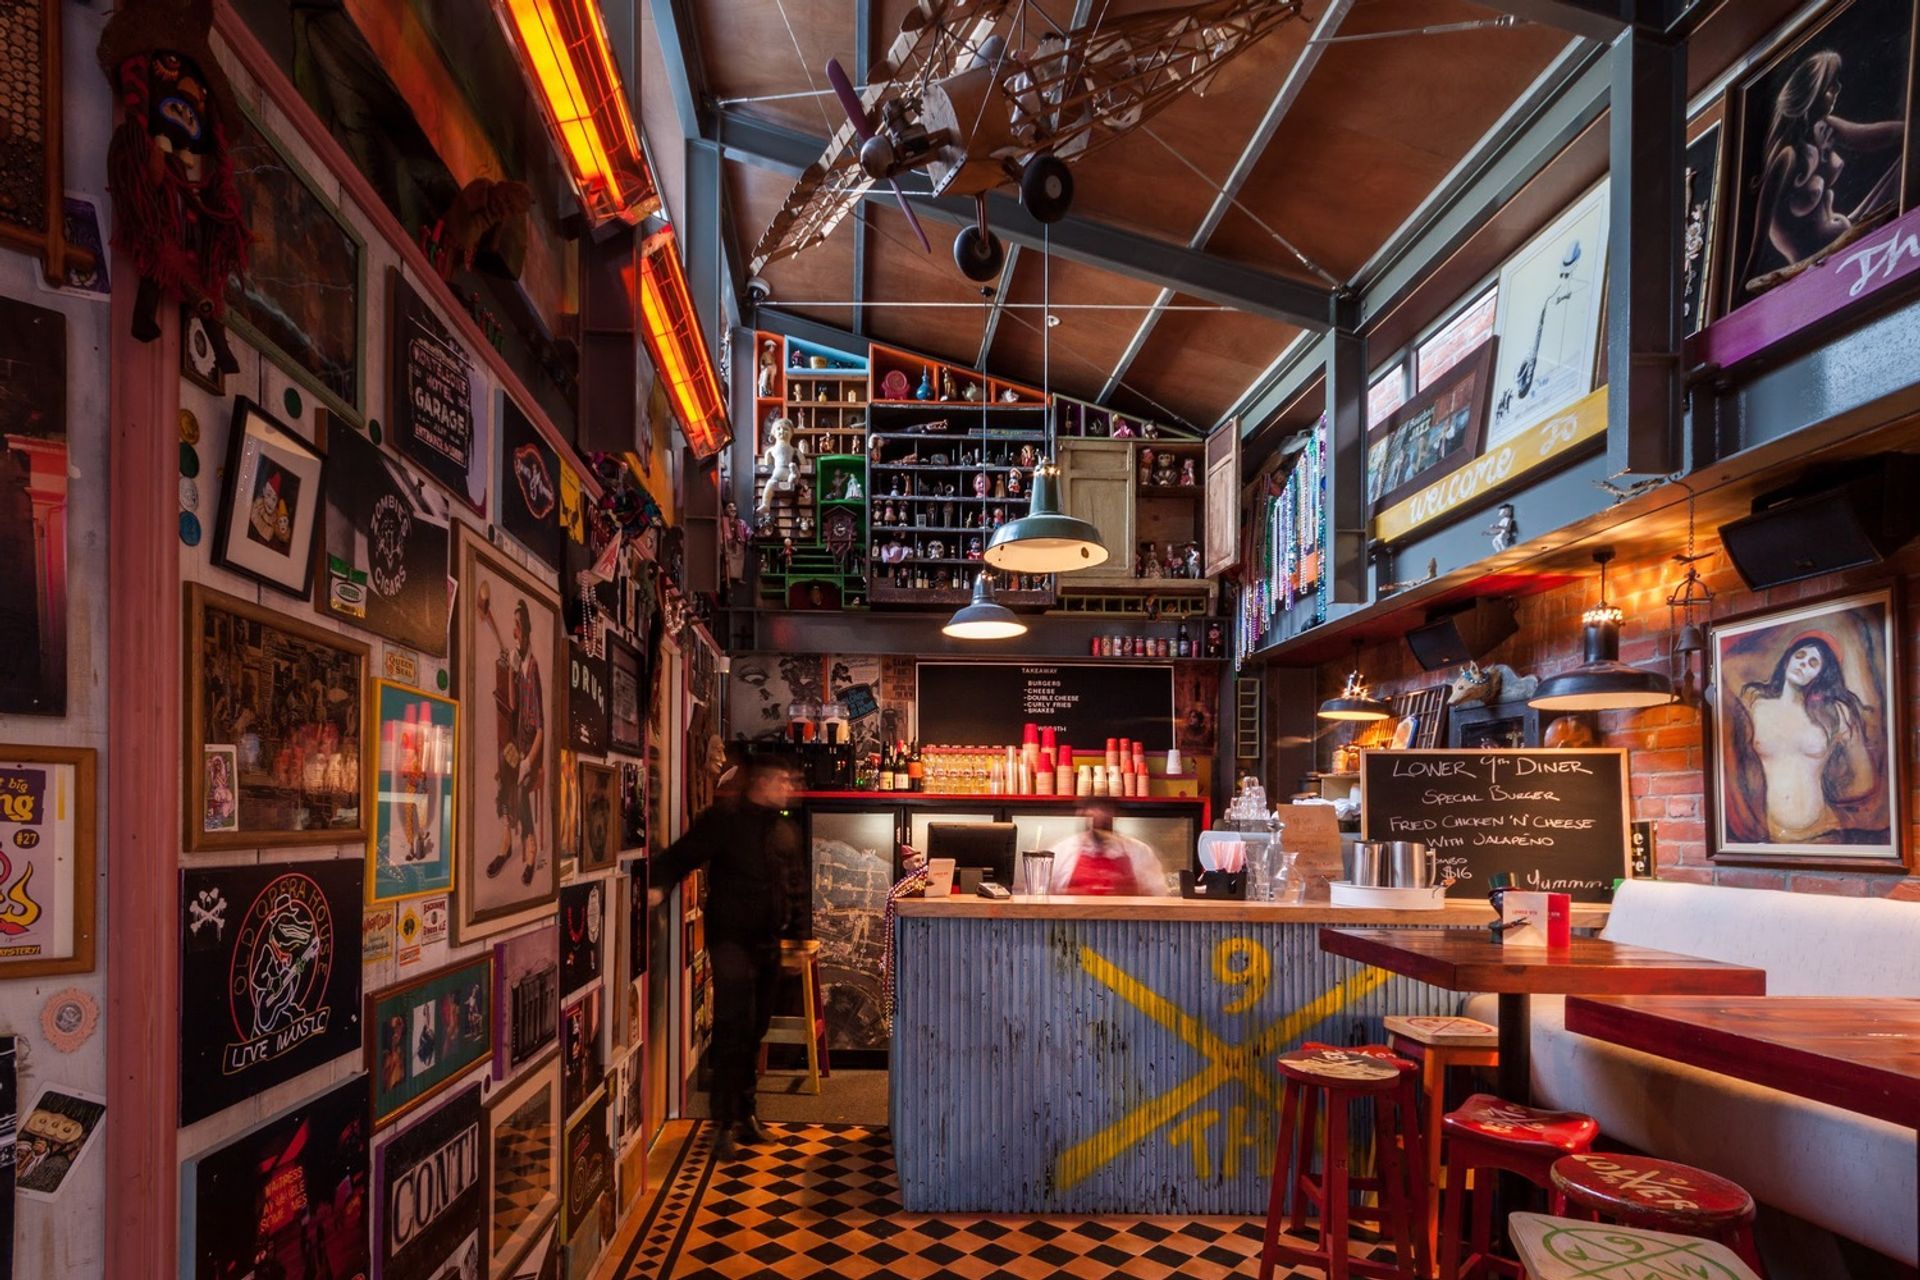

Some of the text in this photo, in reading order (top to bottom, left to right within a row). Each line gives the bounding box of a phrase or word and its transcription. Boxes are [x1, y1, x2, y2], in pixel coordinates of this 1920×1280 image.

[414, 386, 466, 437] GARAGE
[1409, 448, 1515, 524] welcome
[376, 566, 406, 596] CIGARS
[8, 777, 30, 794] big
[1392, 759, 1477, 778] LOWER
[1515, 757, 1593, 776] DINER
[16, 831, 37, 847] #27
[1440, 865, 1473, 880] $16
[309, 889, 332, 977] HOUSE
[438, 920, 447, 931] ALE
[1213, 936, 1271, 1014] 9
[232, 1010, 327, 1067] LIVE MUSIC
[395, 1124, 479, 1245] CONTI
